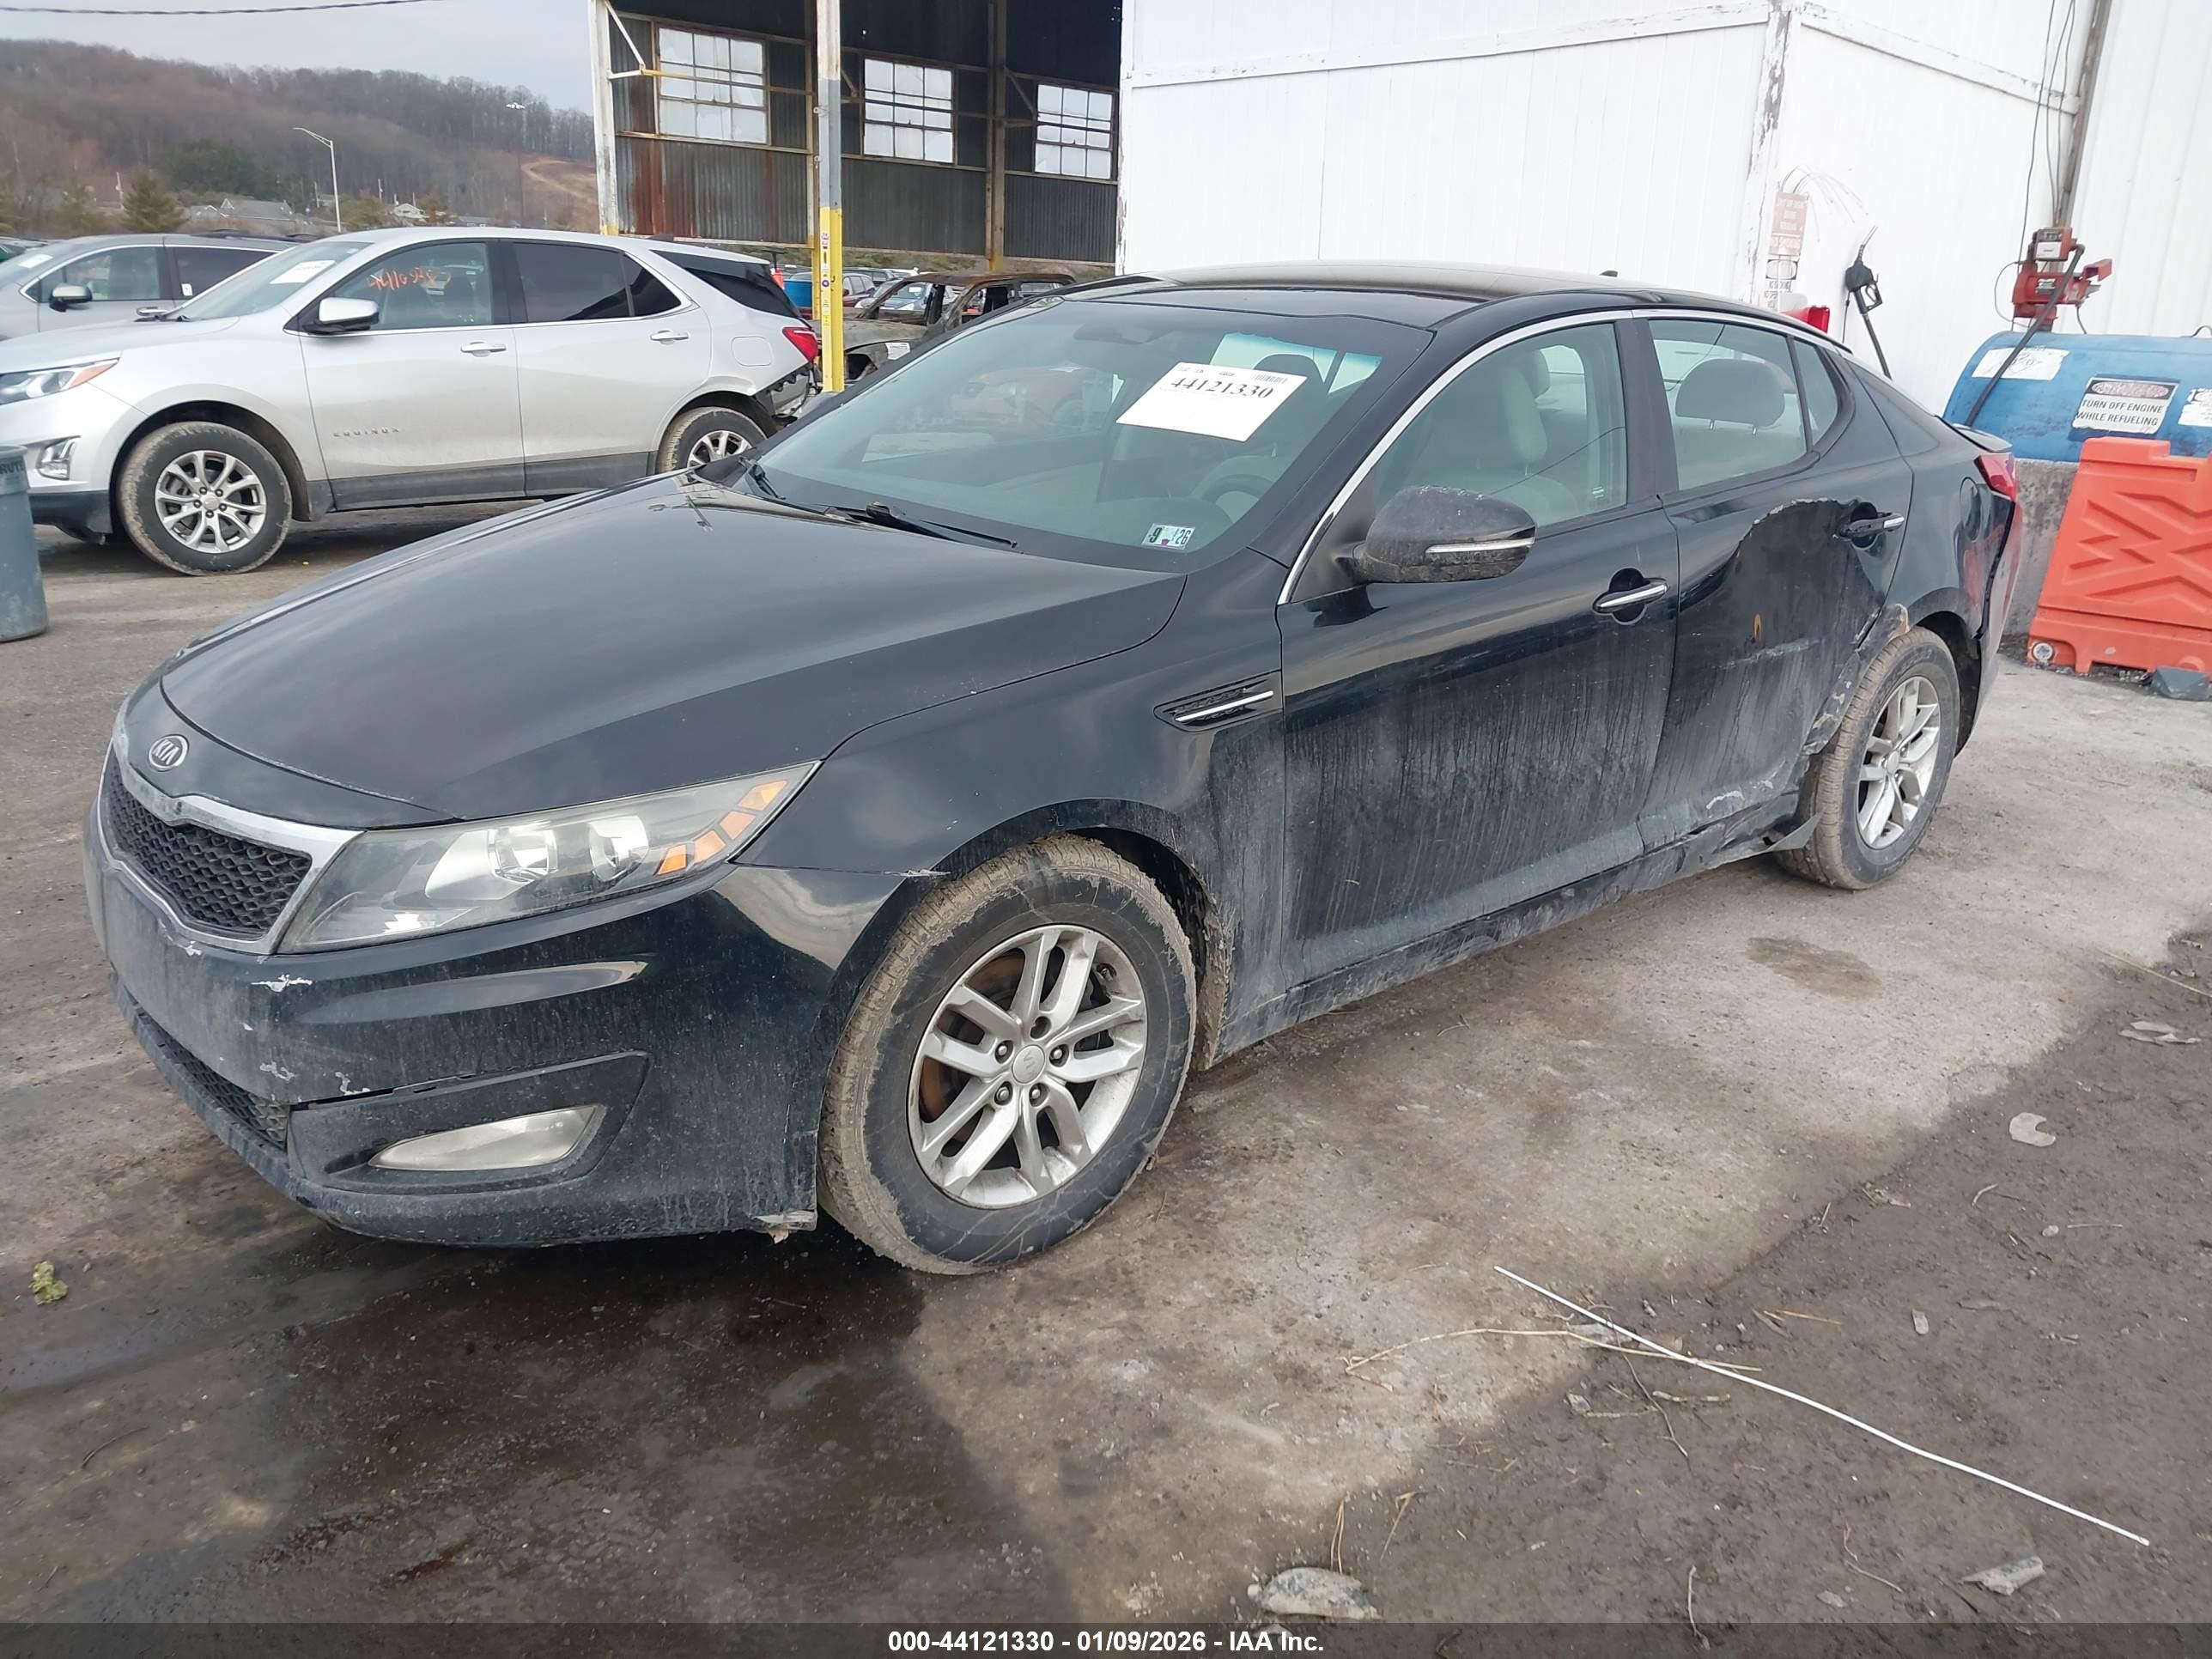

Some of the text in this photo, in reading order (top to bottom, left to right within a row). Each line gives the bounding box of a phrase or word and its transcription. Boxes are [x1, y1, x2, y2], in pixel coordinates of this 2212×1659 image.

[1171, 378, 1273, 398] 44121330
[2082, 398, 2165, 413] TURN OFF ENGINE
[2076, 410, 2158, 425] WHILE REFUELING
[152, 739, 179, 764] KIA
